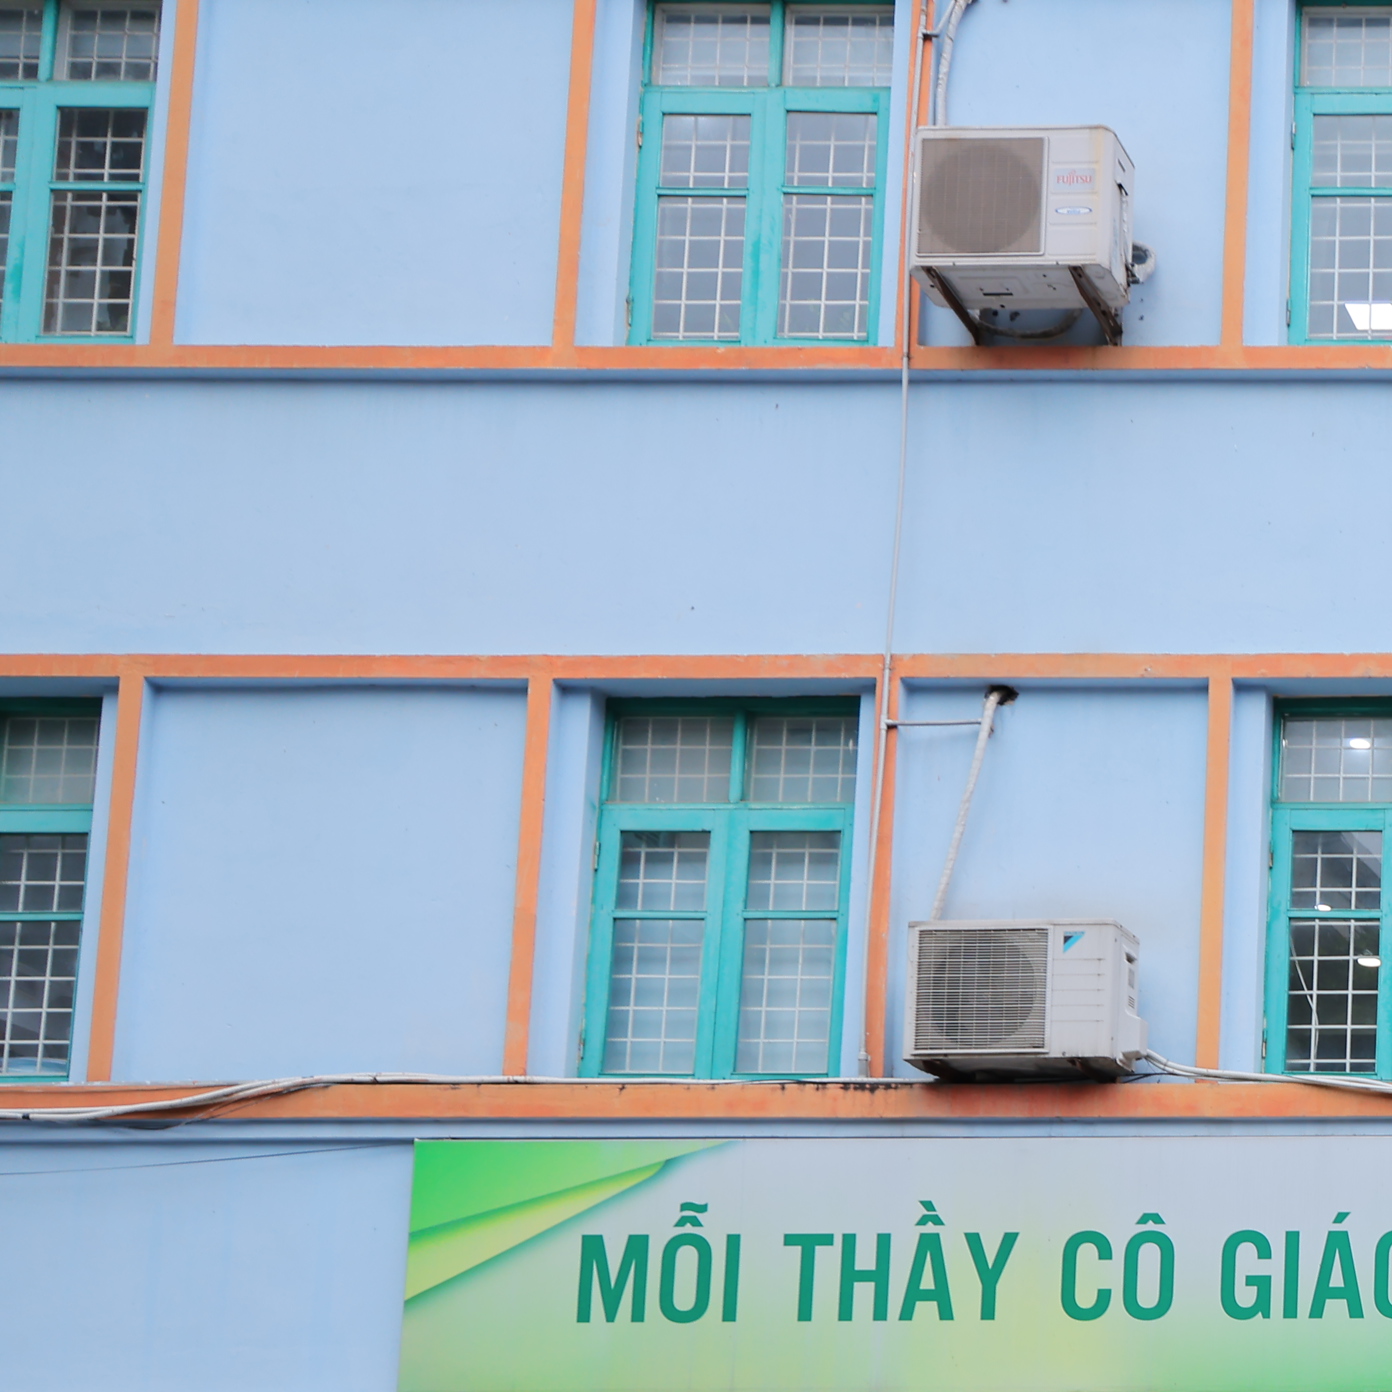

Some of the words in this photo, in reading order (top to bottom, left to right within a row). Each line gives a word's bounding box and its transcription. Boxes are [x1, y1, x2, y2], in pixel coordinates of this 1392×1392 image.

[576, 1202, 741, 1323] MỖI
[784, 1201, 1019, 1321] THẦY
[1061, 1212, 1174, 1321] CÔ
